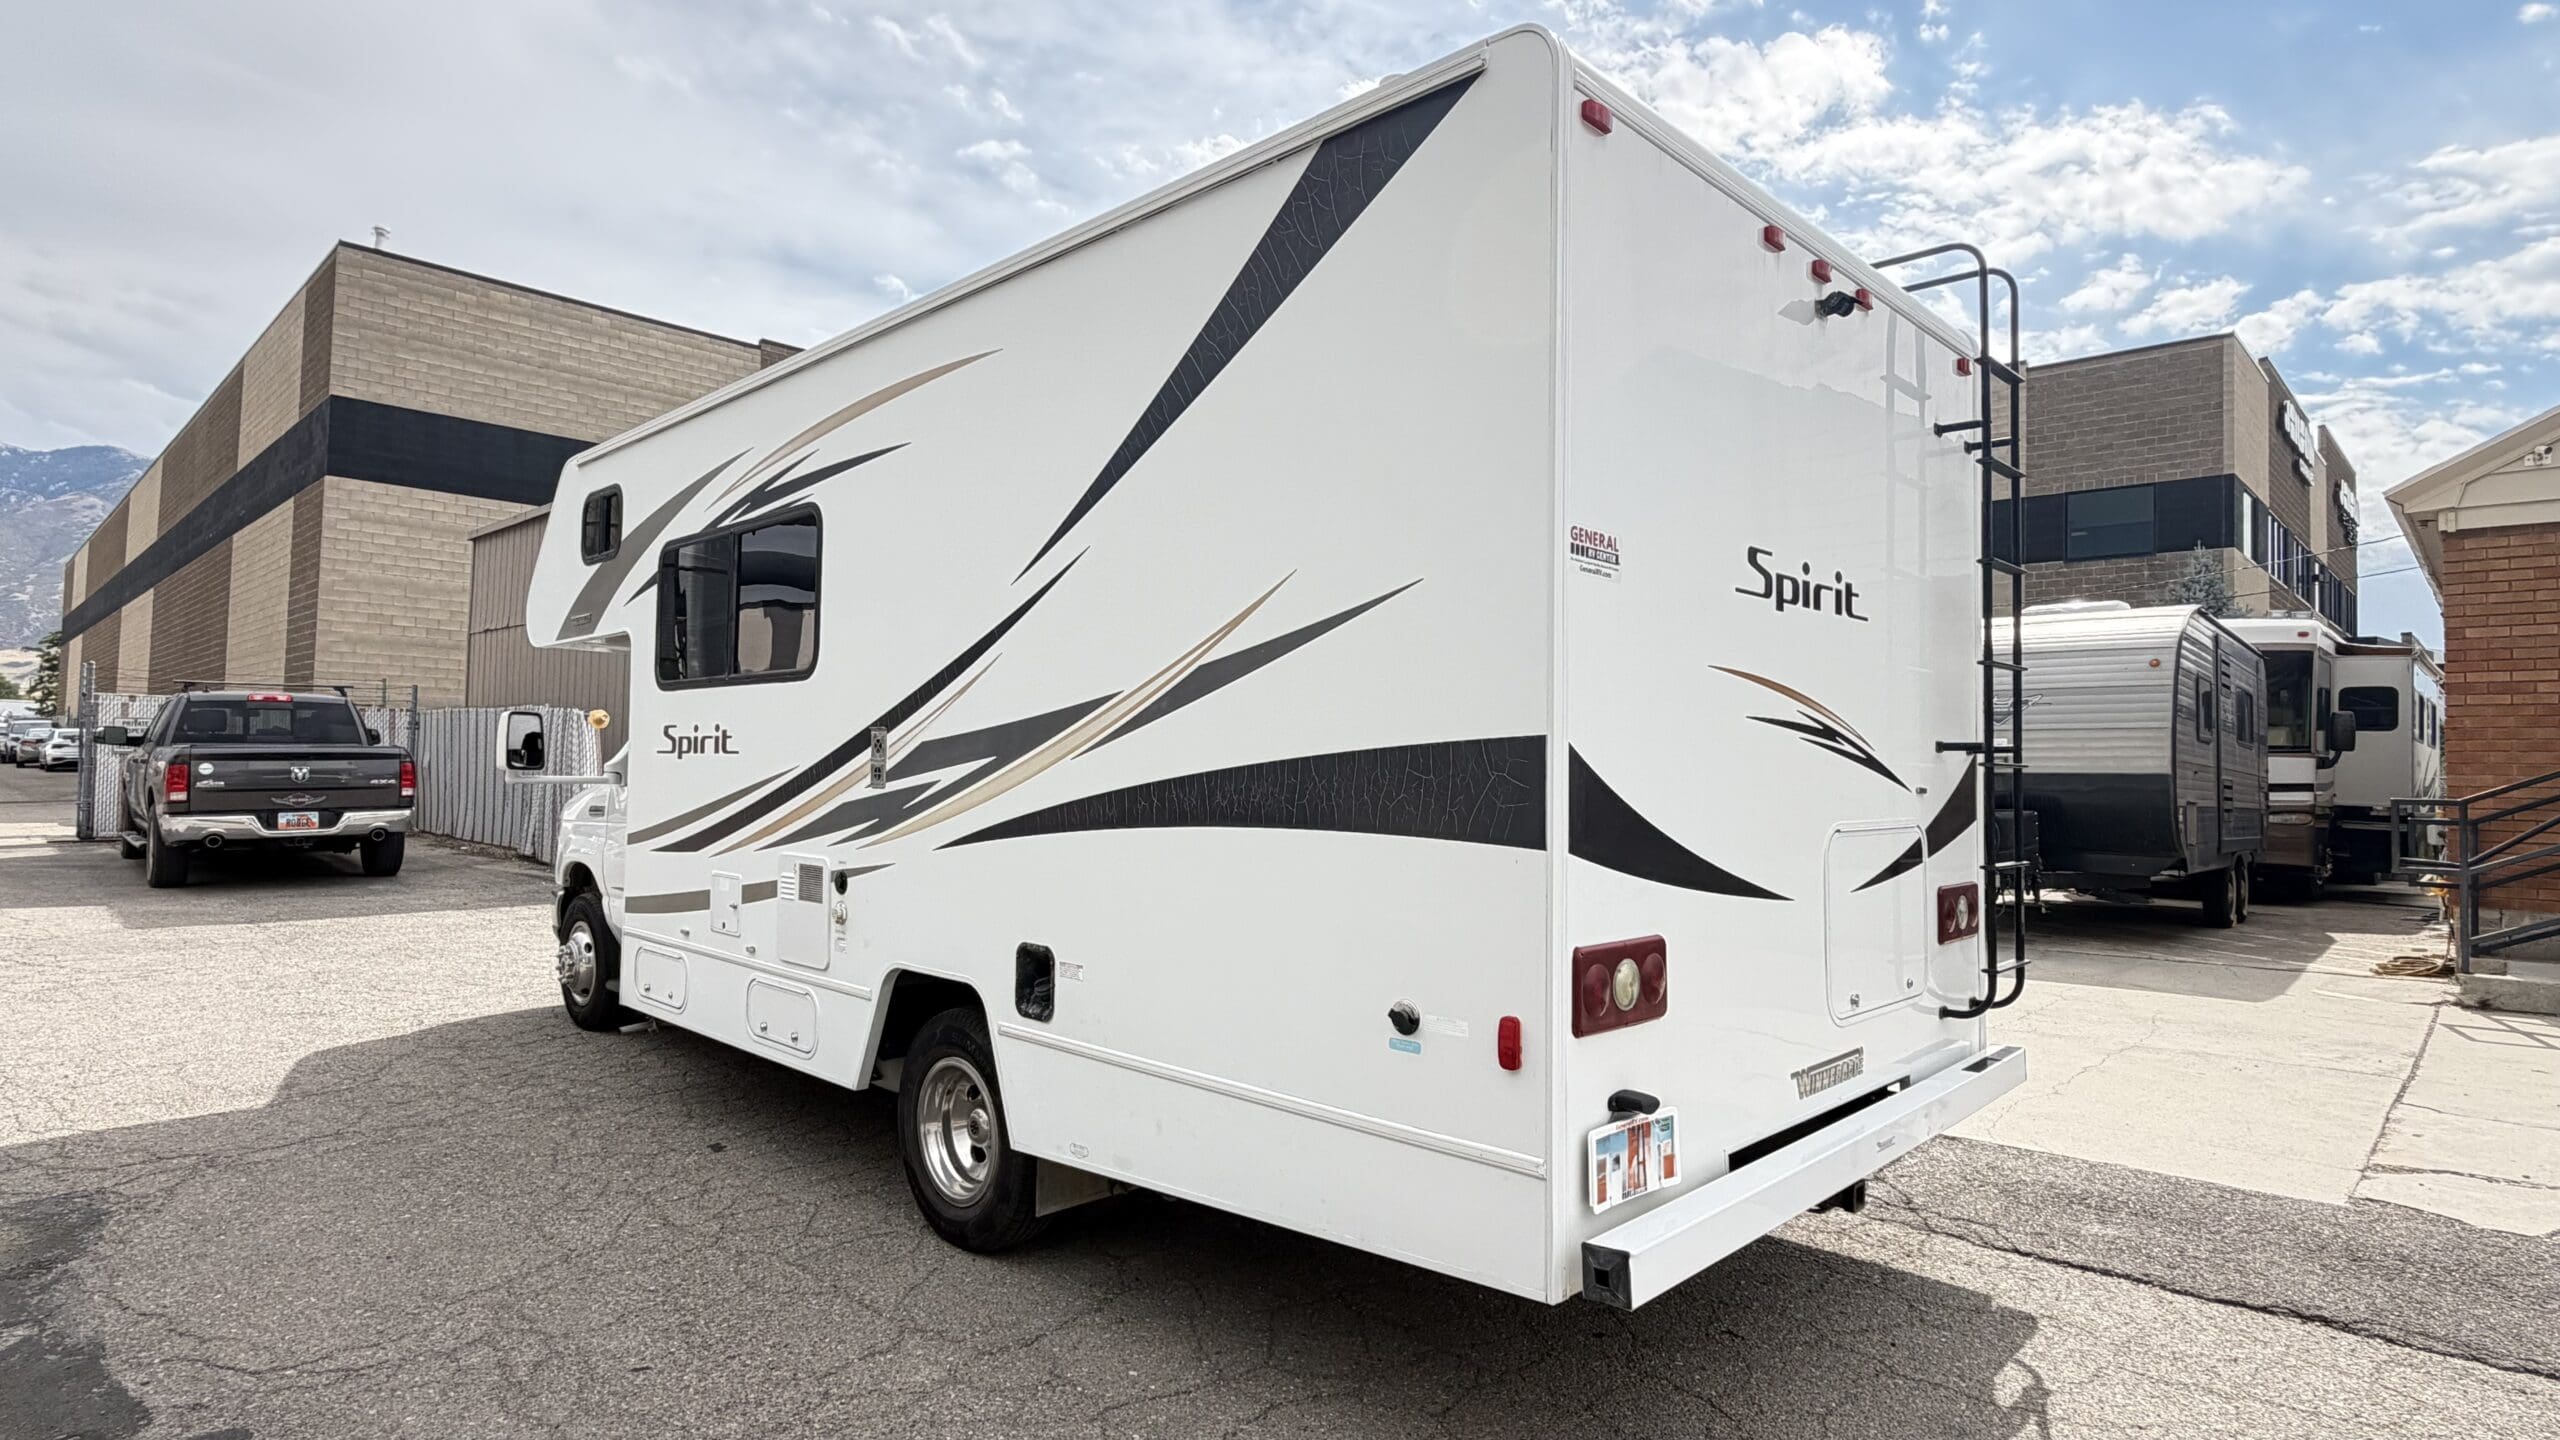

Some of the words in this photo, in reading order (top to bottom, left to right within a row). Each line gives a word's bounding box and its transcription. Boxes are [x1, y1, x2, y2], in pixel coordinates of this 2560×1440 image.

[1570, 525, 1620, 553] GENERAL
[1735, 545, 1869, 622] Spirit
[656, 723, 740, 760] Spirit
